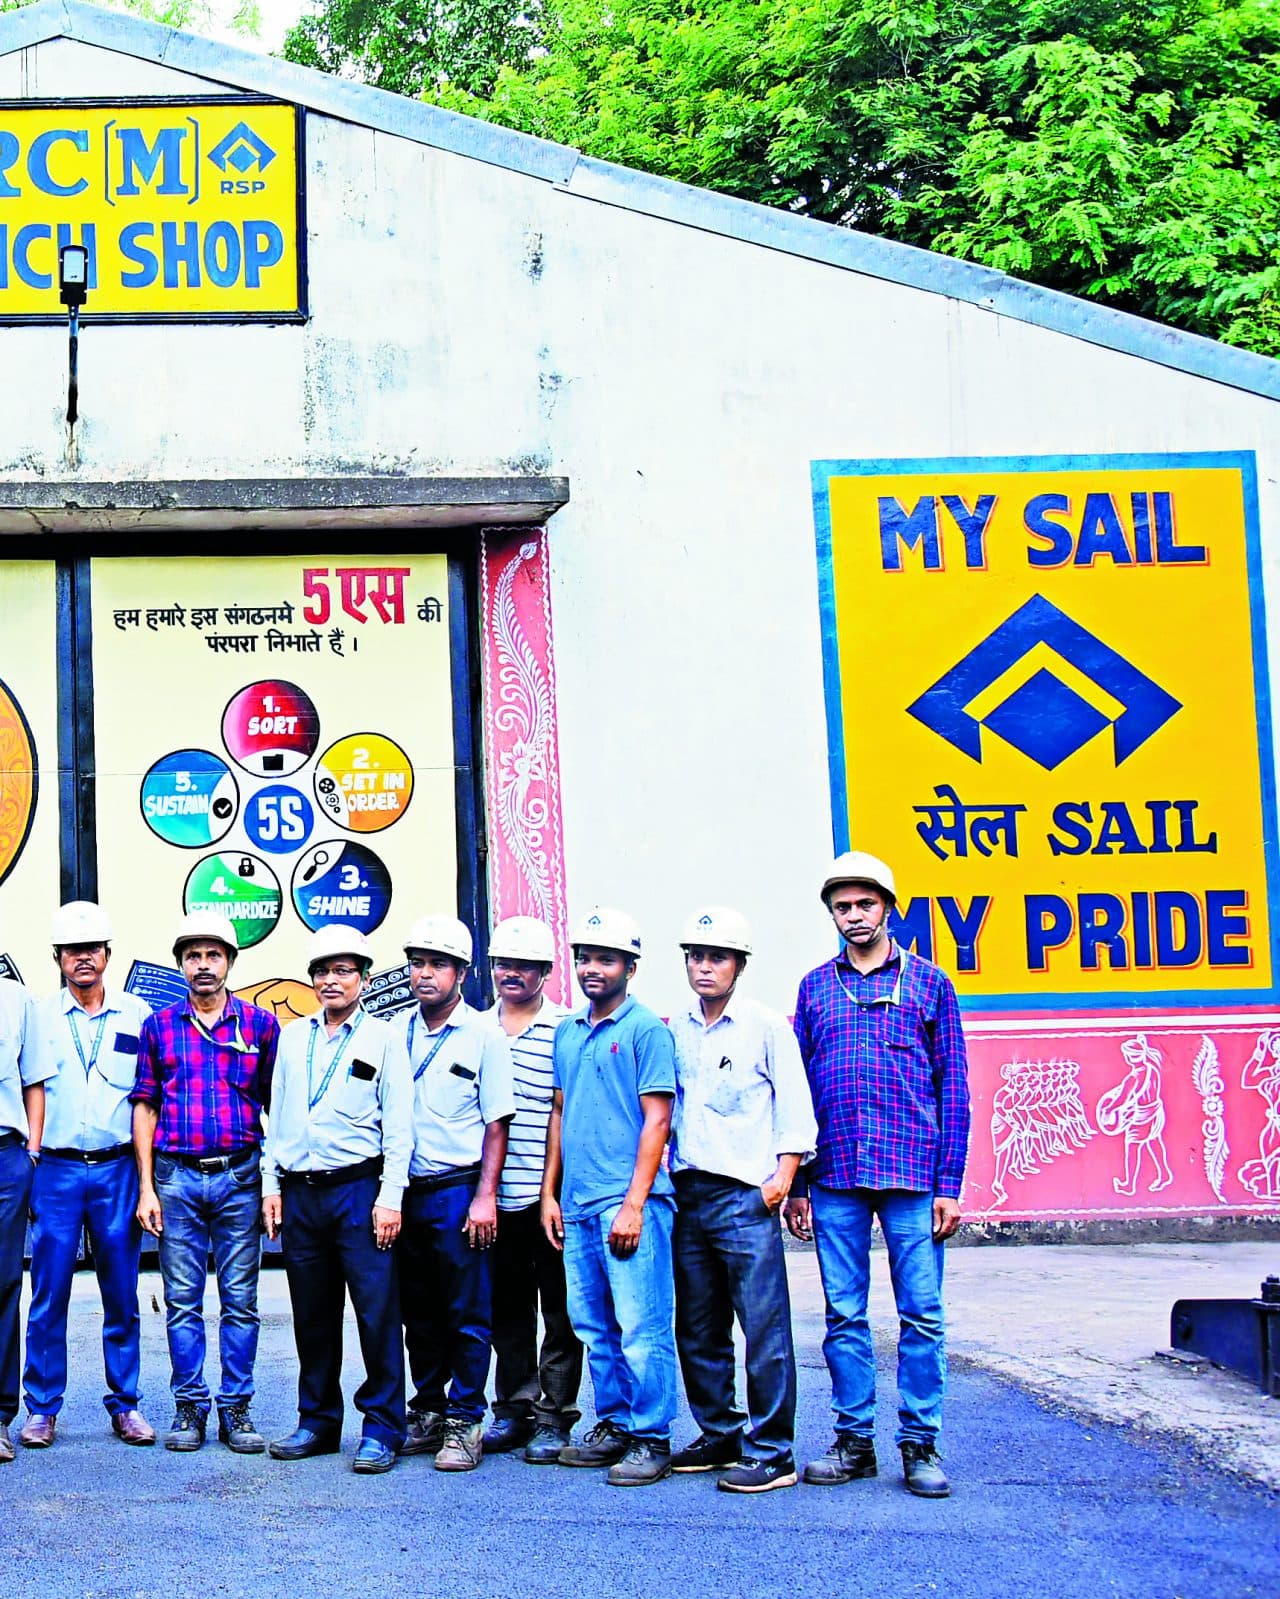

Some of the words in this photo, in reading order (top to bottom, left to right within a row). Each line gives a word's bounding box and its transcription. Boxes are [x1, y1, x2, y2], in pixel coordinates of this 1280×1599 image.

[220, 180, 266, 195] RSP
[119, 220, 283, 289] SHOP
[877, 494, 996, 571] MY
[1022, 491, 1209, 568] SAIL
[113, 608, 140, 631] हम
[145, 603, 186, 631] हमारे
[190, 607, 218, 630] इस
[416, 597, 444, 623] की
[264, 629, 322, 653] निभाते
[263, 696, 281, 713] 1.
[247, 716, 298, 736] SORT
[352, 748, 380, 769] 2.
[175, 771, 198, 792] 5.
[341, 773, 378, 791] SET
[383, 773, 405, 790] IN
[144, 793, 209, 817] SUSTAIN
[347, 794, 400, 812] ORDER
[257, 795, 305, 841] 5S
[912, 783, 1027, 862] सेल
[1047, 799, 1217, 857] SAIL
[209, 876, 235, 896] 4.
[340, 865, 368, 890] 3.
[308, 895, 371, 917] SHINE
[1024, 889, 1253, 972] PRIDE
